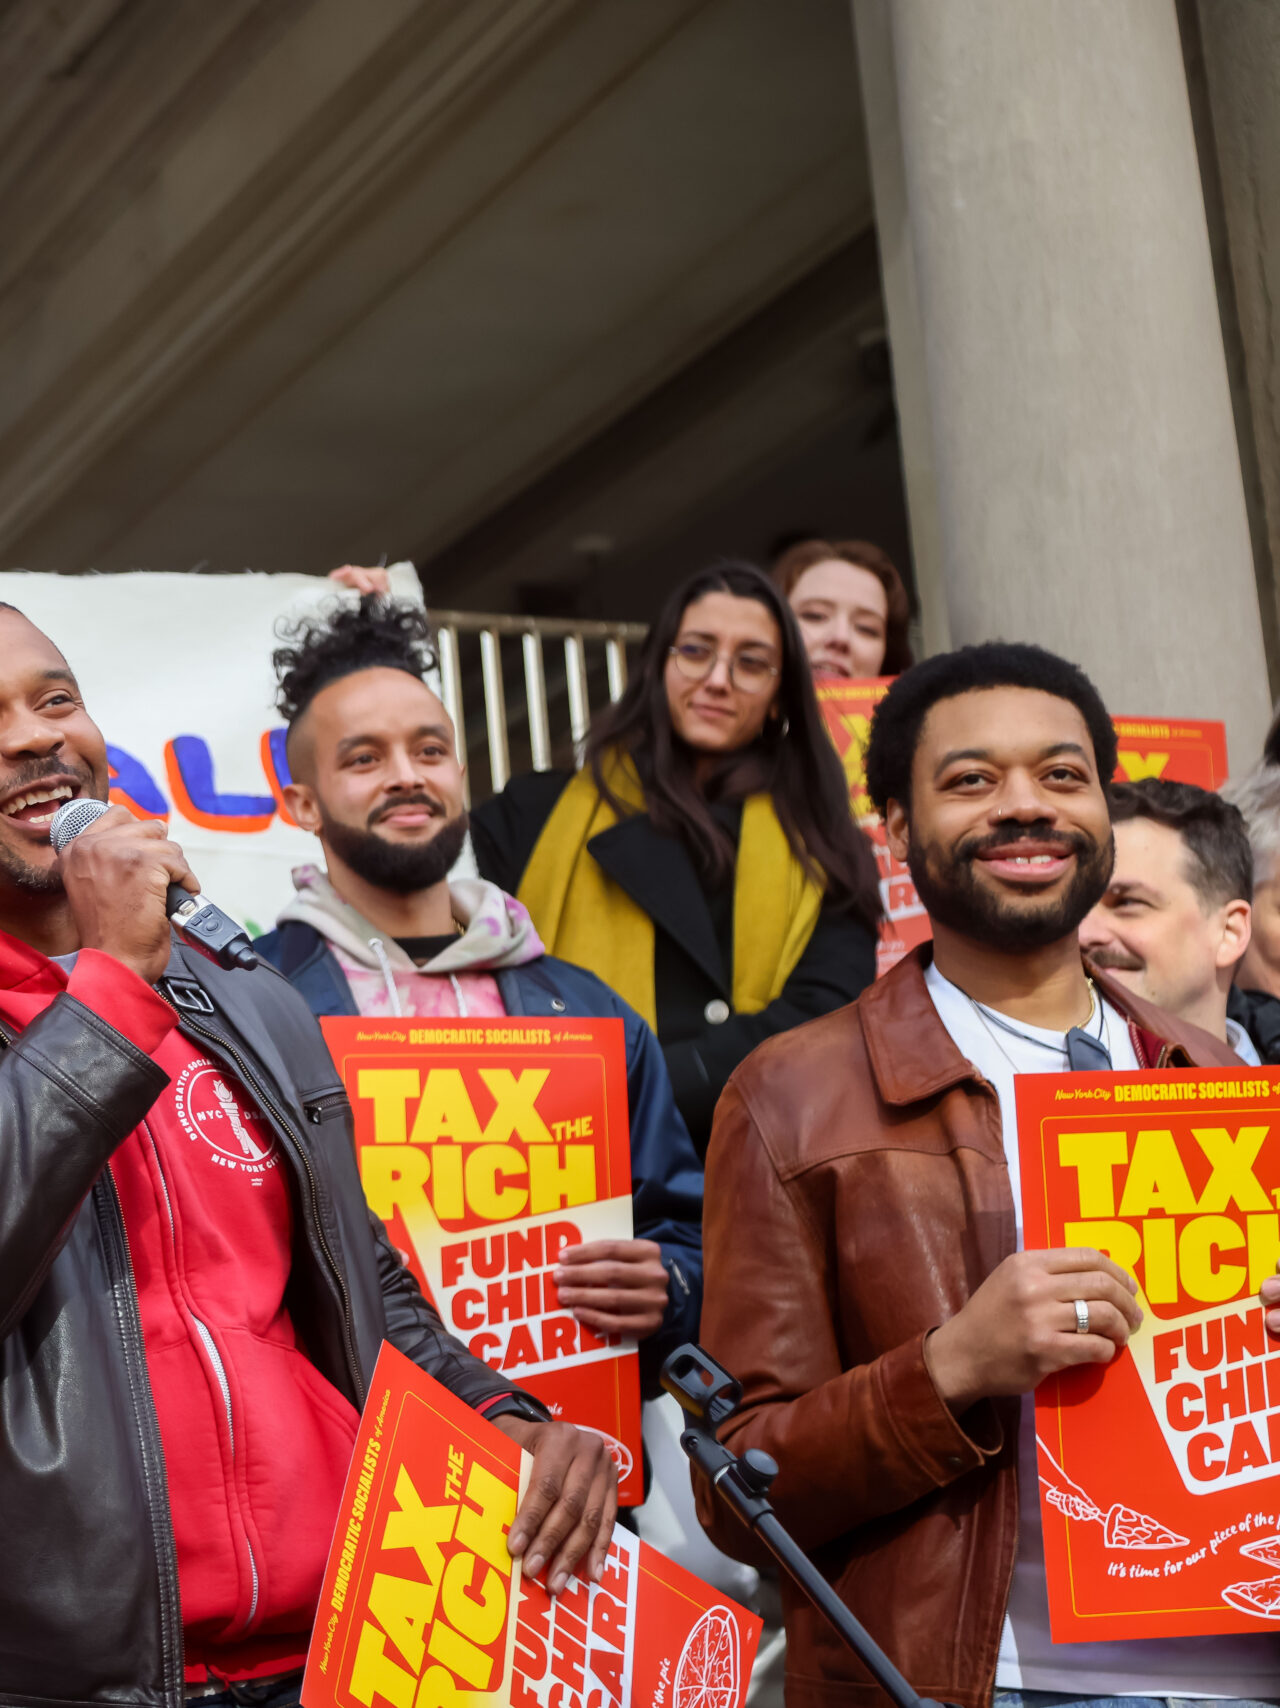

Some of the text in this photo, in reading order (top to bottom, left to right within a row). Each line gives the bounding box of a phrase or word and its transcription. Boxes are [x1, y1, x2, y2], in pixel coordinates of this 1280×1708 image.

[409, 1029, 484, 1045] DEMOCRATIC
[486, 1028, 552, 1045] SOCIALISTS
[174, 1069, 199, 1142] DEMOCRATIC
[196, 1109, 224, 1122] NYC
[357, 1068, 554, 1143] TAX
[1055, 1089, 1074, 1101] New
[1073, 1088, 1093, 1100] York
[1092, 1087, 1112, 1101] City
[1114, 1082, 1196, 1102] DEMOCRATIC
[1198, 1080, 1270, 1100] SOCIALISTS
[551, 1116, 593, 1142] THE
[211, 1153, 237, 1170] NEW
[240, 1162, 266, 1174] YORK
[360, 1144, 597, 1220] RICH
[1058, 1126, 1274, 1218] TAX
[441, 1221, 583, 1288] FUND
[452, 1271, 572, 1331] CHIL
[444, 1444, 465, 1501] THE
[319, 1389, 391, 1675] New York City DEMOCRATIC SOCIALISTS of America
[1107, 1561, 1127, 1578] It's
[1129, 1563, 1161, 1578] time
[1163, 1560, 1184, 1576] for
[1185, 1547, 1207, 1567] our
[1209, 1525, 1238, 1555] piece
[1238, 1513, 1253, 1532] of
[1254, 1512, 1275, 1528] the
[349, 1462, 459, 1708] TAX
[510, 1571, 552, 1708] FUN
[659, 1657, 671, 1685] pie
[653, 1681, 666, 1704] the
